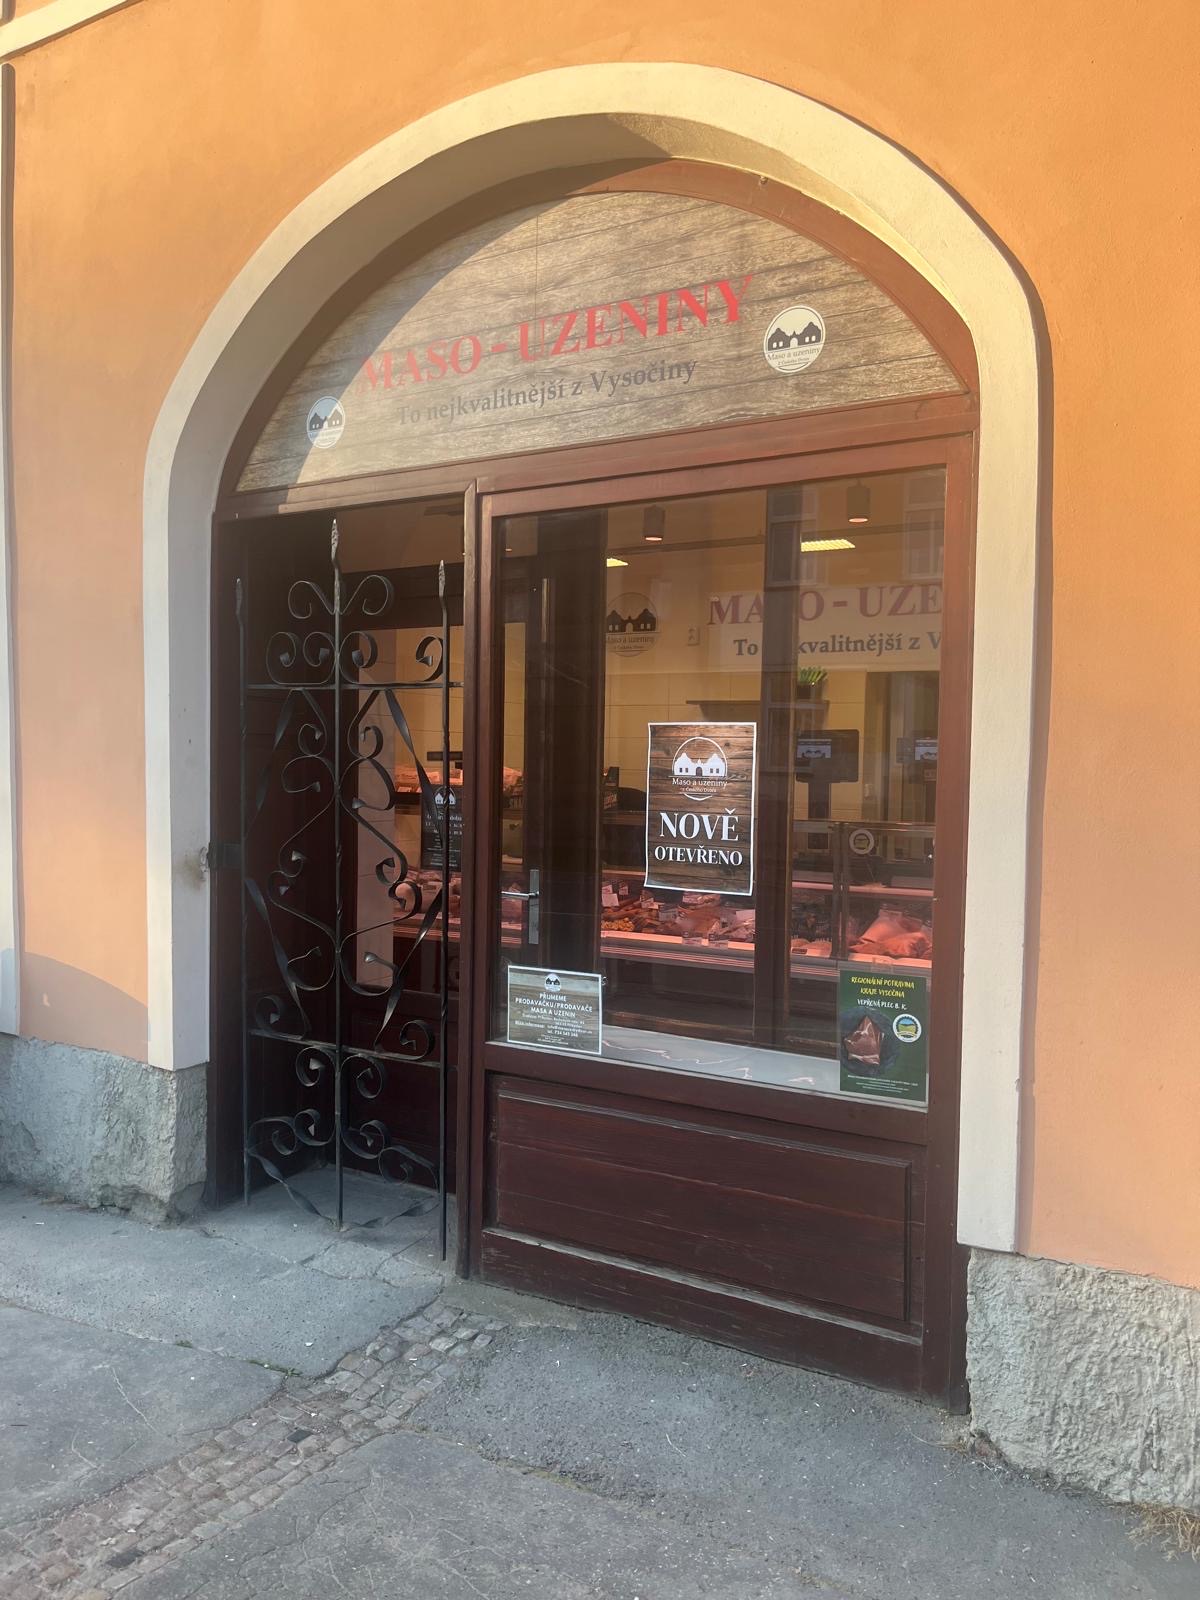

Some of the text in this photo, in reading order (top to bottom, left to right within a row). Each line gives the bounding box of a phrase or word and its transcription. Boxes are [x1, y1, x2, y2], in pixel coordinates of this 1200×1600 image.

[397, 359, 698, 425] To nejkvalitnější z Vysočiny
[707, 589, 825, 625] MAO
[733, 638, 759, 656] To
[908, 637, 921, 650] z
[672, 777, 691, 786] Maso
[698, 779, 728, 790] uzeniny
[659, 807, 739, 841] NOVĚ
[654, 844, 743, 866] OTEVŘENO
